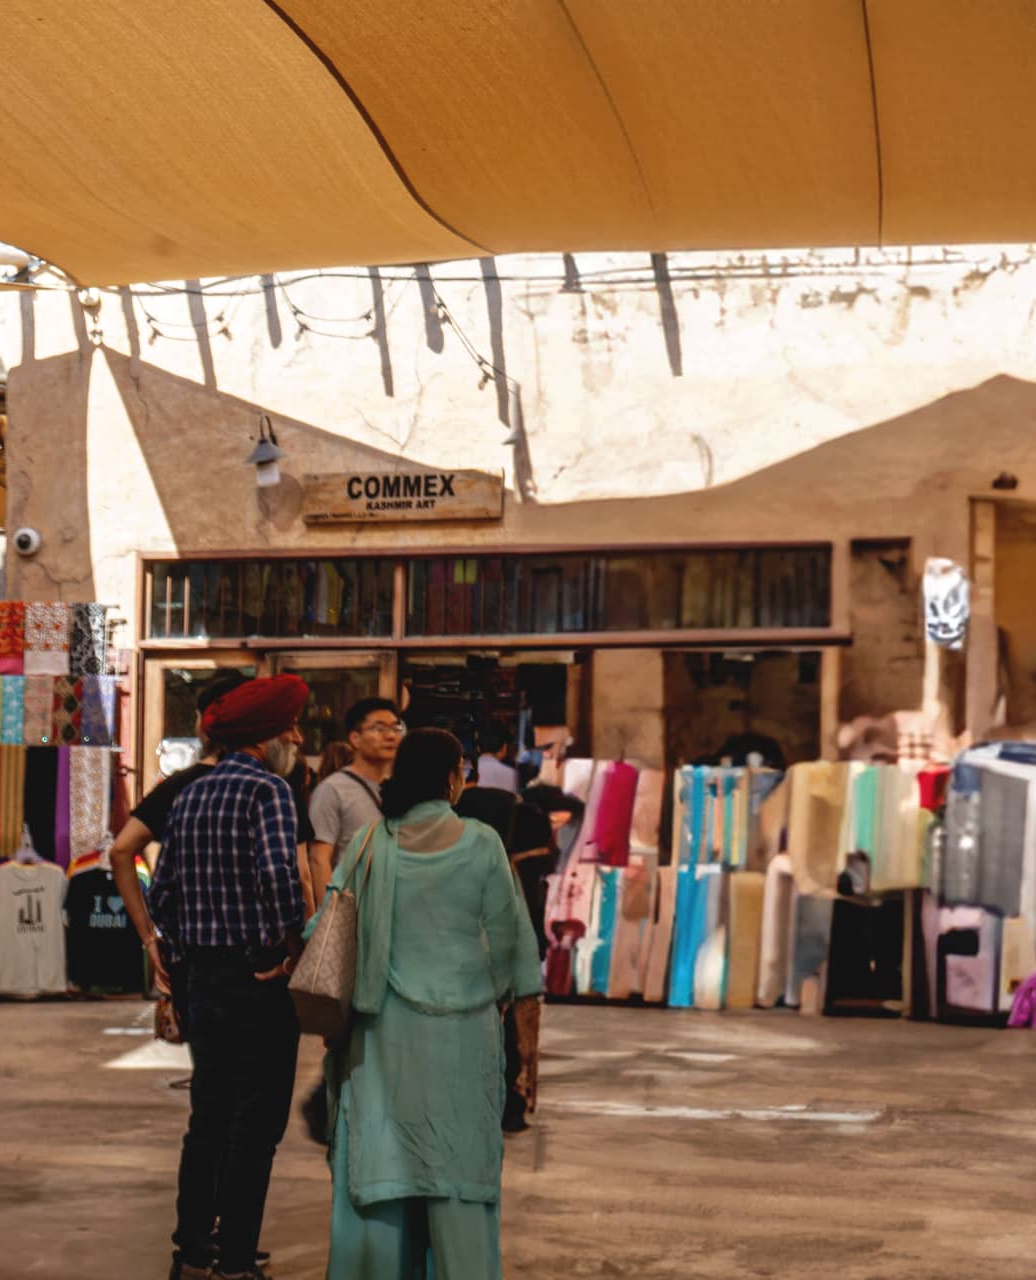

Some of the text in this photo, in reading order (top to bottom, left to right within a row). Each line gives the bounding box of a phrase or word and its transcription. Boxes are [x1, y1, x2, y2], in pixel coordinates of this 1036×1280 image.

[347, 474, 455, 500] COMMEX
[366, 499, 436, 510] KASHMIR ART
[93, 896, 103, 912] I
[89, 913, 127, 928] DUBAI
